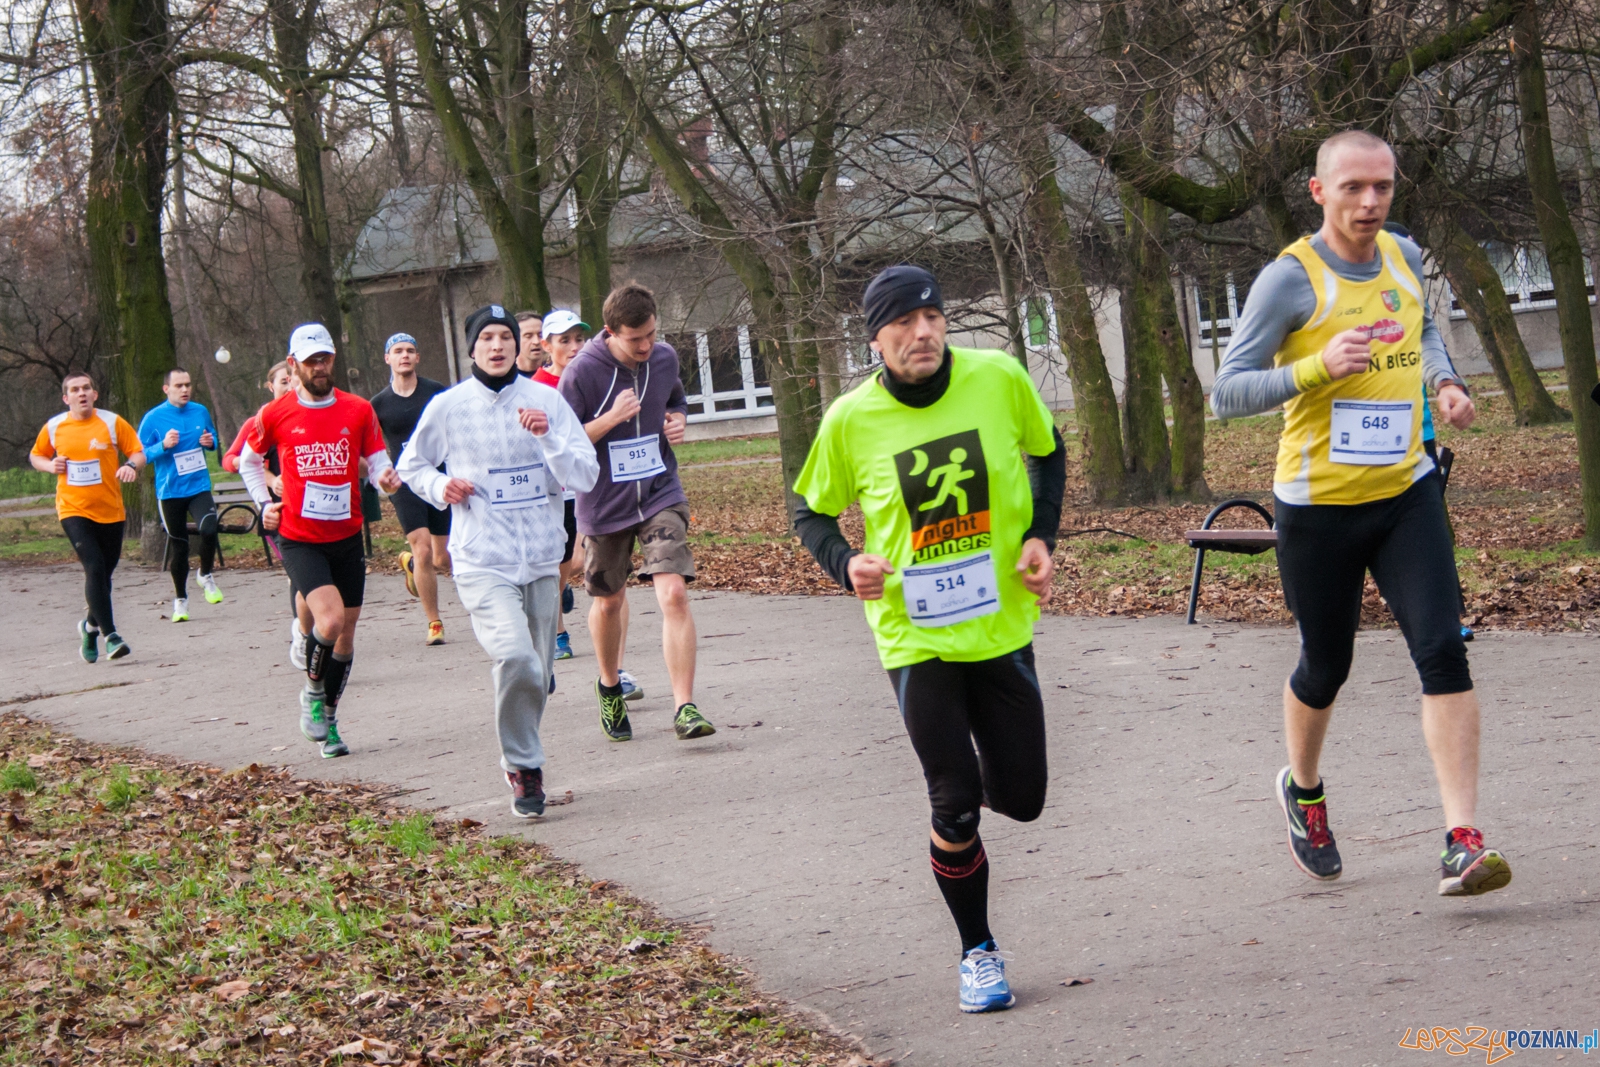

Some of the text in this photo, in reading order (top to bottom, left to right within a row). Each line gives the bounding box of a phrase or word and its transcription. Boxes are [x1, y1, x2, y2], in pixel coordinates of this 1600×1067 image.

[1362, 415, 1389, 430] 648
[294, 441, 342, 455] DRUŻYNA
[629, 448, 647, 460] 915
[296, 452, 350, 470] SZPIKU
[510, 474, 529, 486] 394
[322, 493, 340, 502] 774
[923, 515, 977, 542] night
[914, 532, 991, 562] unners
[935, 574, 966, 593] 514
